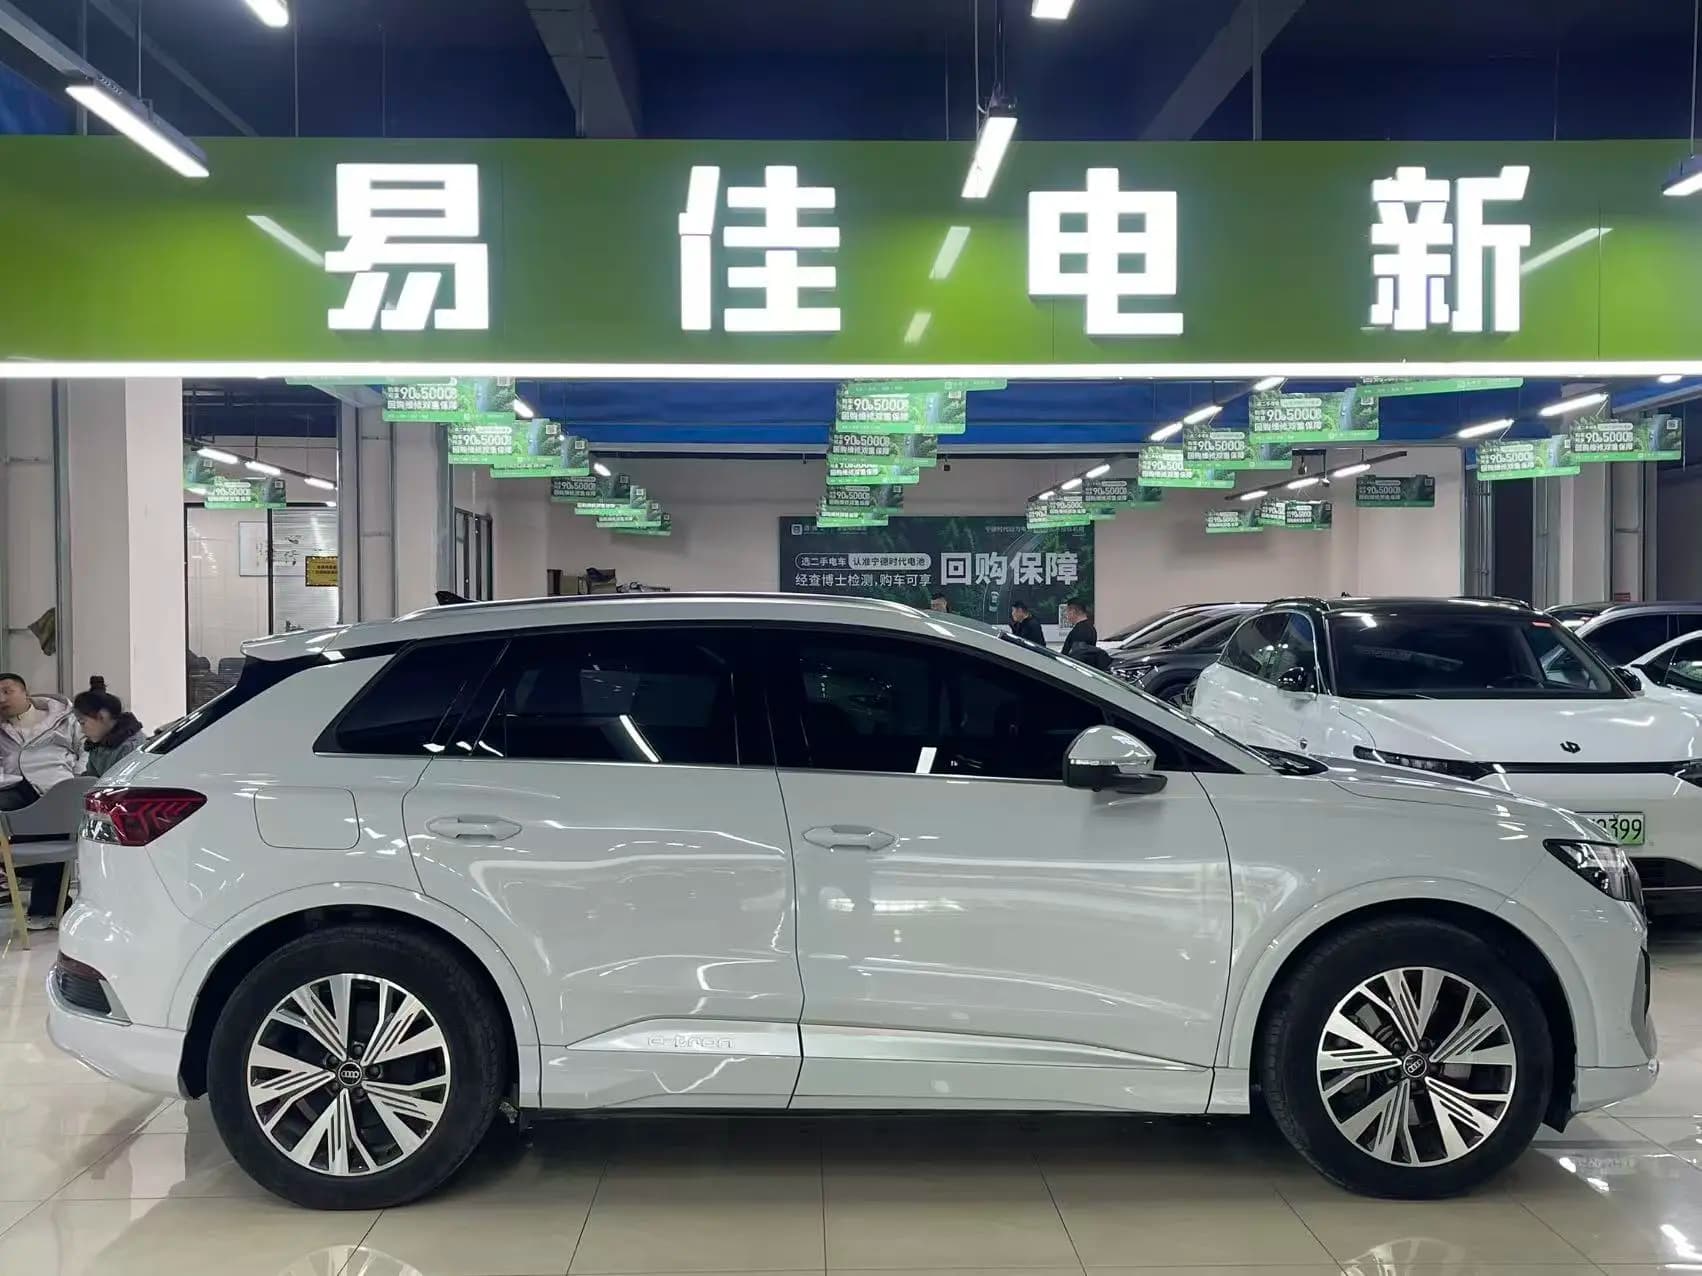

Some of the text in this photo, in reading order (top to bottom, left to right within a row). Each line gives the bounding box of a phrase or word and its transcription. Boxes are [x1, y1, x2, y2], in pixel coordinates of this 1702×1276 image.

[325, 163, 1531, 336] 易佳电新
[853, 556, 926, 566] 认准宁德时代电池
[940, 552, 1078, 585] 回购保障
